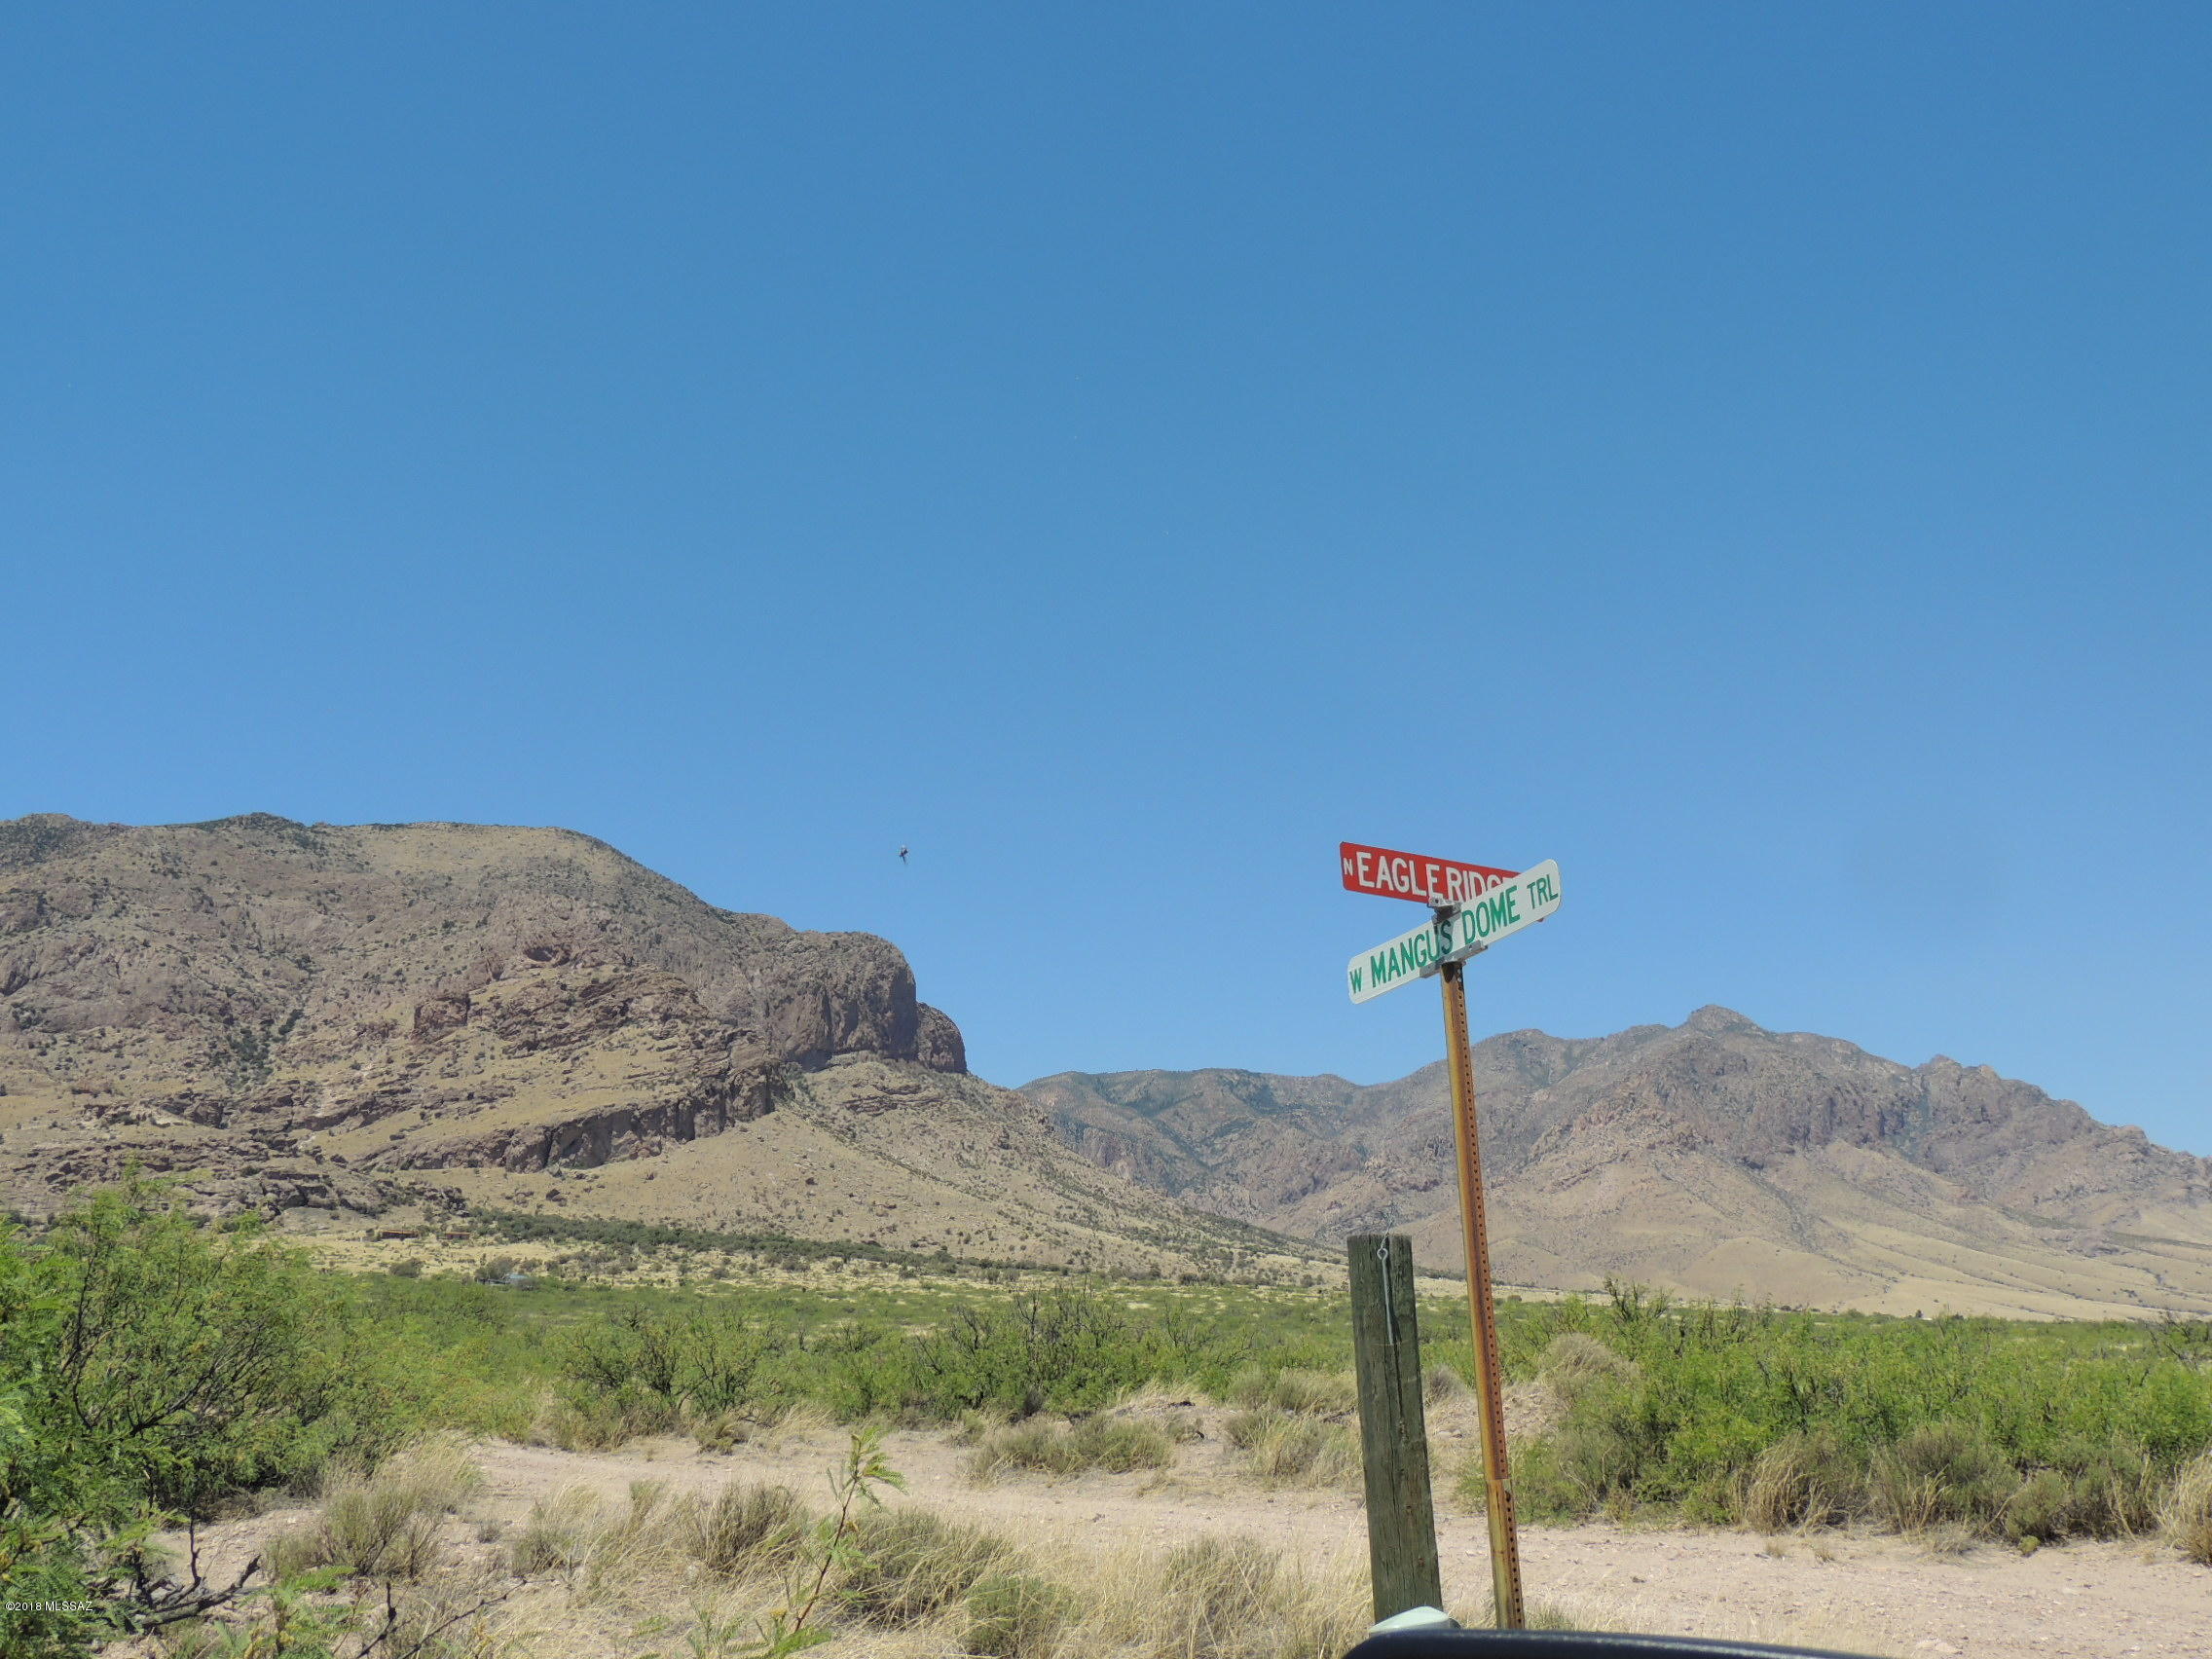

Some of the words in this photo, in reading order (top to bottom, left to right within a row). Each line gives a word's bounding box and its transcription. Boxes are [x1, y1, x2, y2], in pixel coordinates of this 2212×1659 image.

[1343, 858, 1353, 876] N
[1356, 851, 1444, 898] EAGLE
[1349, 967, 1362, 994] W
[1370, 920, 1454, 988] MANGUS
[1461, 885, 1521, 945] DOME
[1527, 874, 1559, 909] TRL
